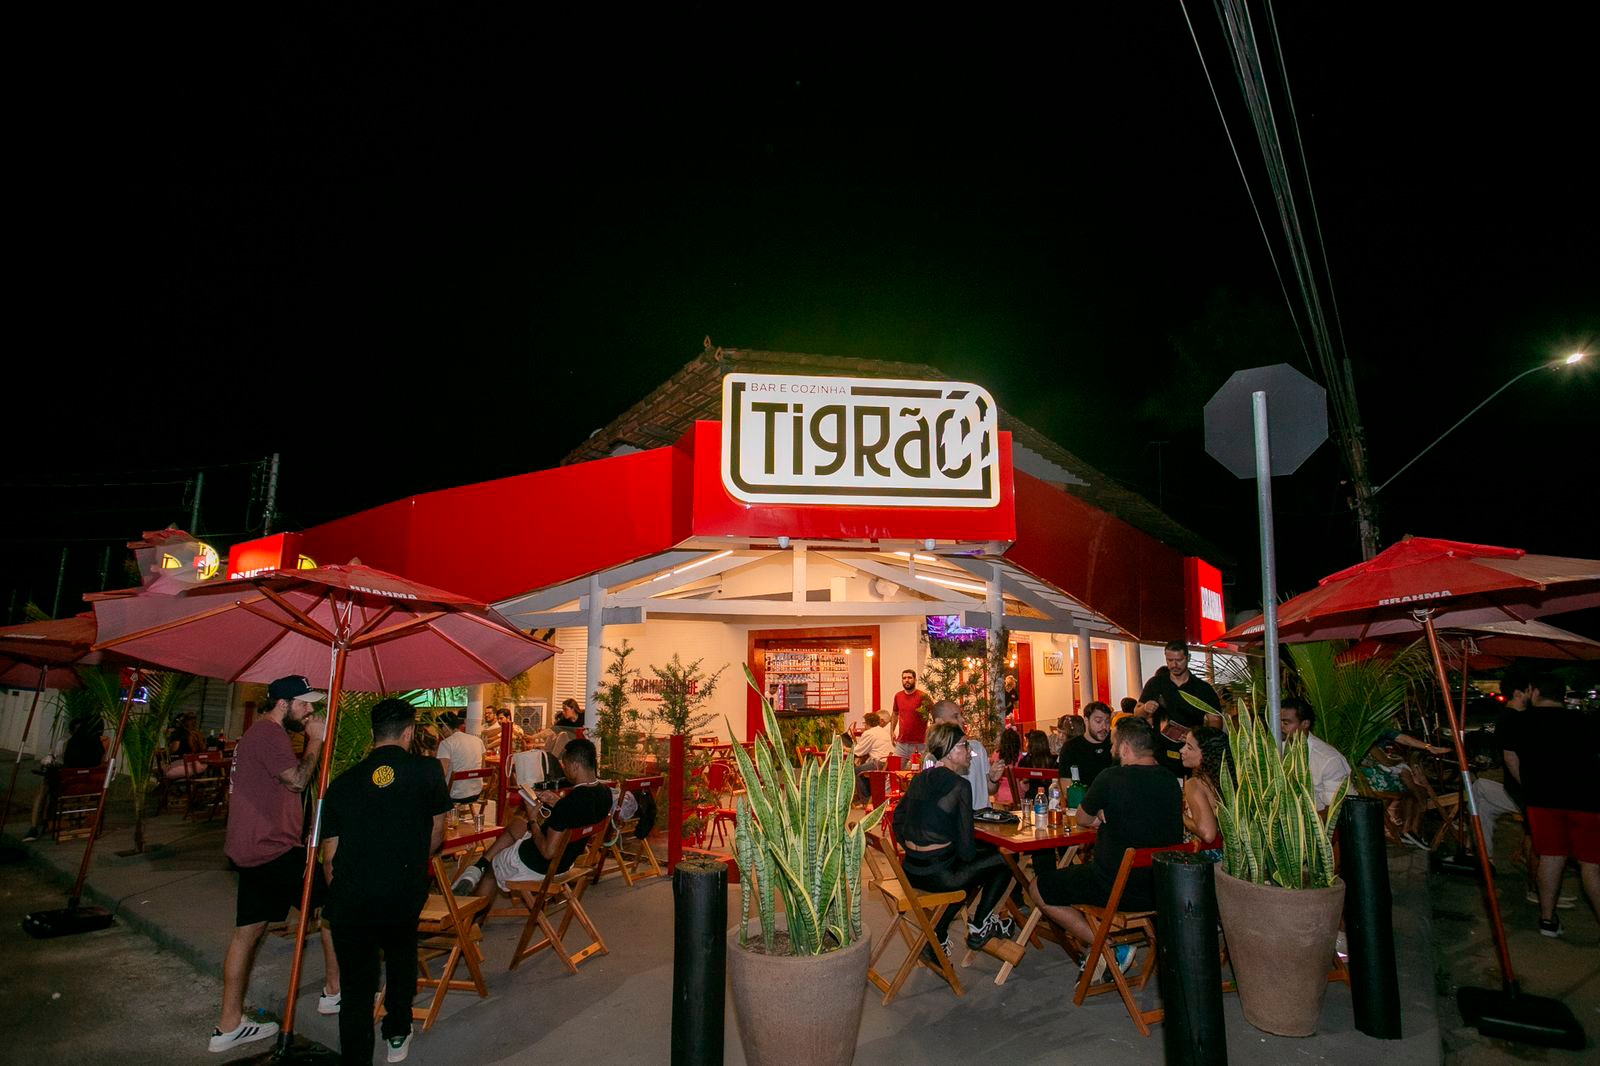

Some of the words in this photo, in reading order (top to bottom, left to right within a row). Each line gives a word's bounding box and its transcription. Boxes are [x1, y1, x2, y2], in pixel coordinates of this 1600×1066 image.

[751, 382, 776, 392] BAR
[780, 383, 788, 393] E
[791, 384, 847, 394] COZINHA
[1378, 590, 1453, 606] BRAHMA
